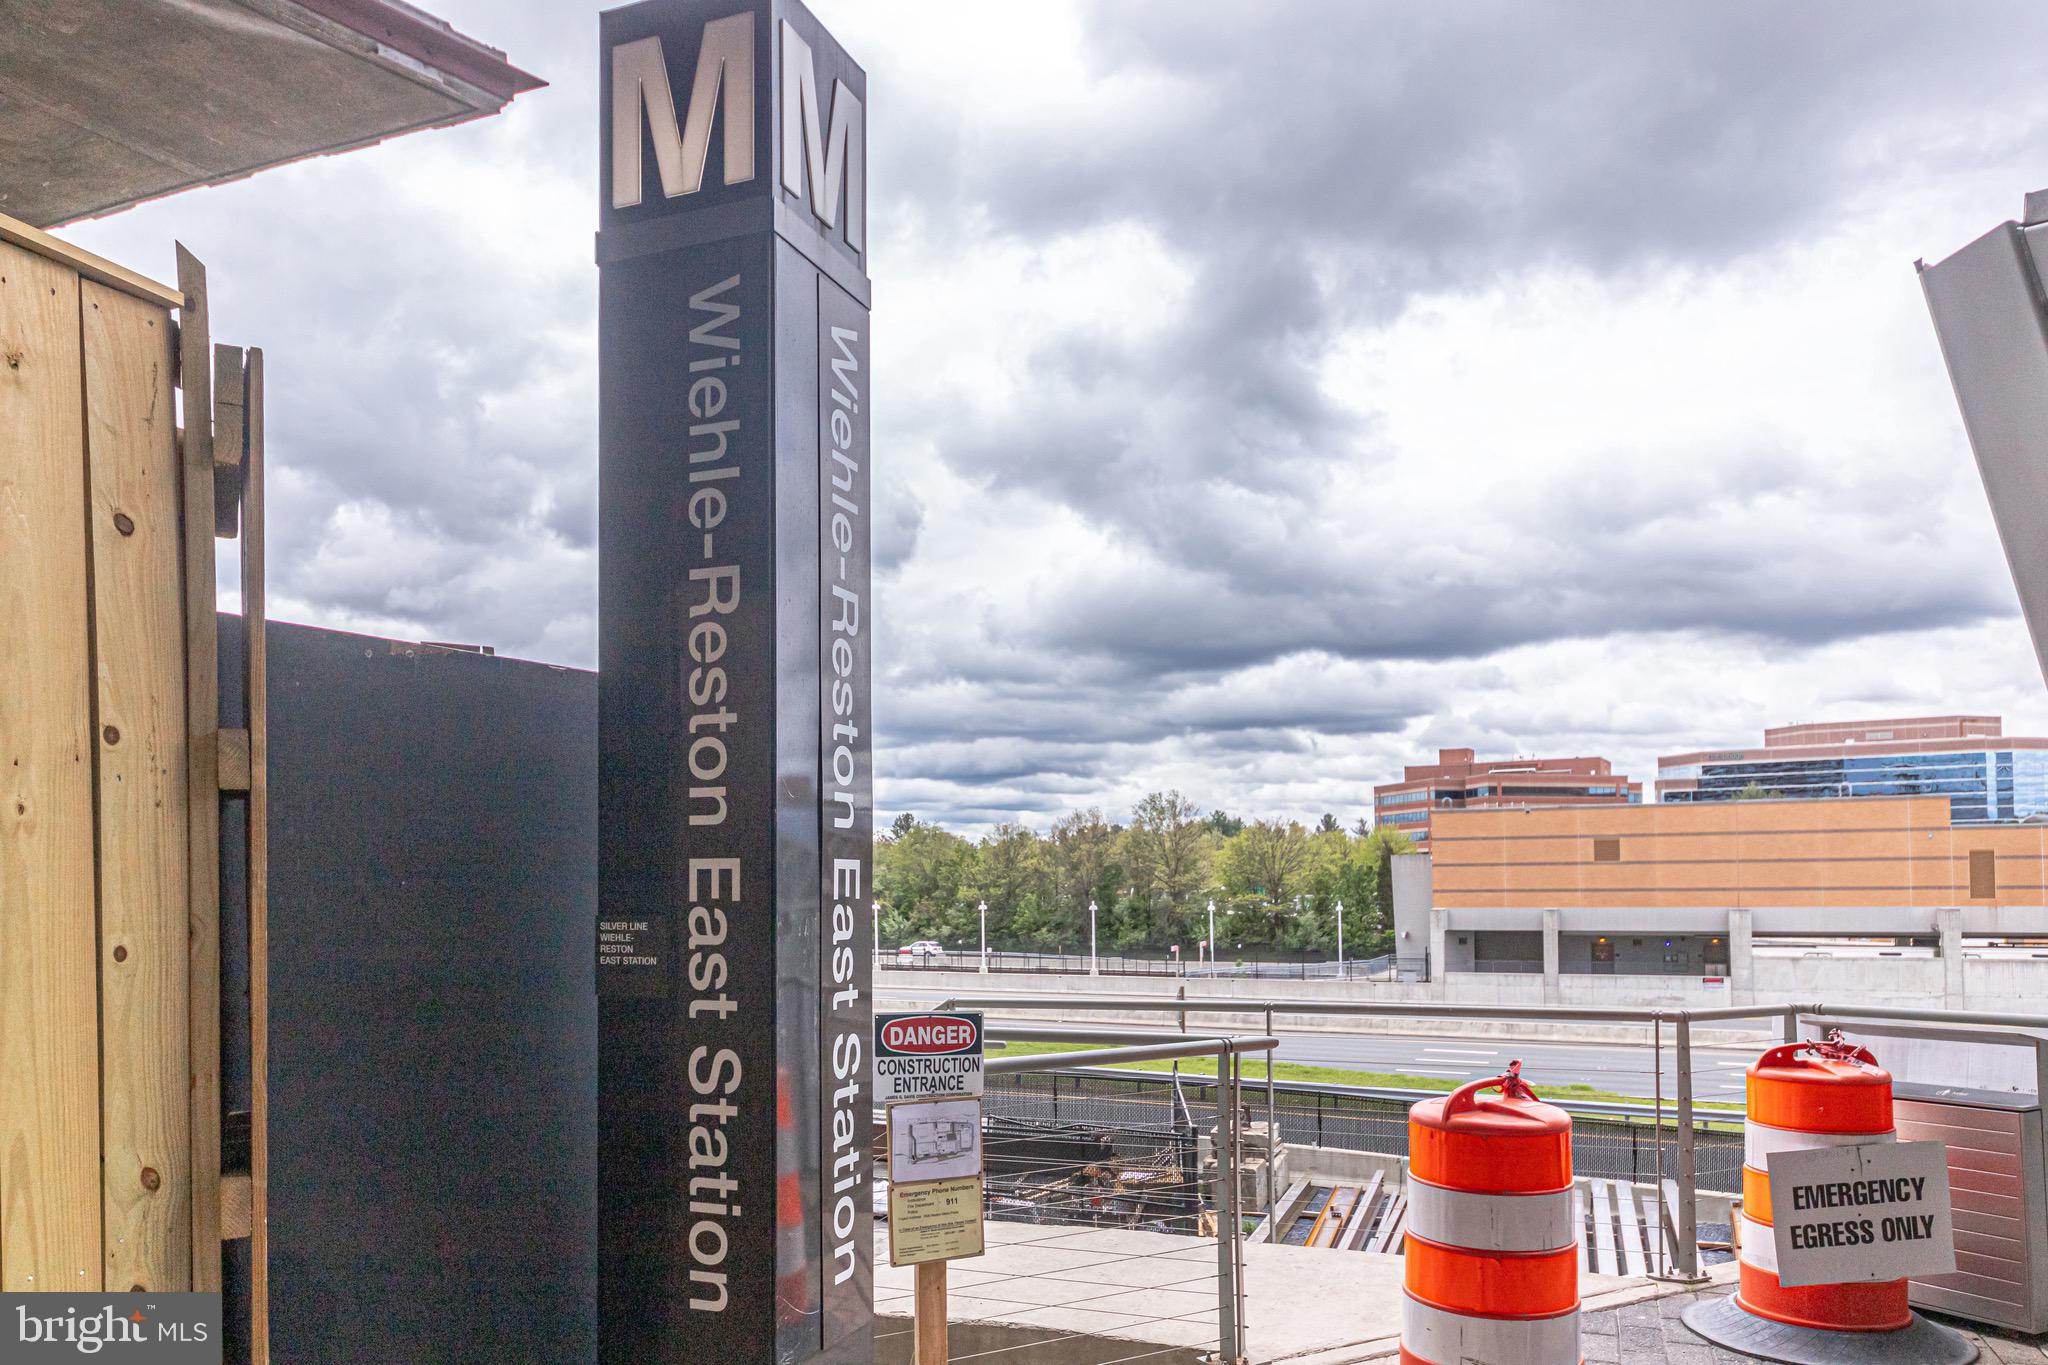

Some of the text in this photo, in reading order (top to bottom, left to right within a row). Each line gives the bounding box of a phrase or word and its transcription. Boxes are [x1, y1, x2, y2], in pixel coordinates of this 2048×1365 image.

[612, 10, 756, 209] M
[780, 18, 864, 254] M
[688, 273, 742, 1312] Wiehle-Reston East Station
[830, 326, 862, 1286] Wiehle-Reston East Station
[600, 922, 648, 931] SILVER LINE
[600, 933, 634, 942] WIEHLE-
[600, 945, 633, 953] RESTON
[600, 956, 656, 965] EAST STATION
[890, 1025, 971, 1046] DANGER
[877, 1056, 980, 1076] CONSTRUCTION
[893, 1075, 964, 1093] ENTRANCE
[899, 1189, 931, 1198] Emergency
[950, 1184, 974, 1192] Numbers
[945, 1197, 958, 1205] 911
[1792, 1177, 1925, 1211] EMERGENCY
[1790, 1214, 1935, 1250] EGRESS ONLY
